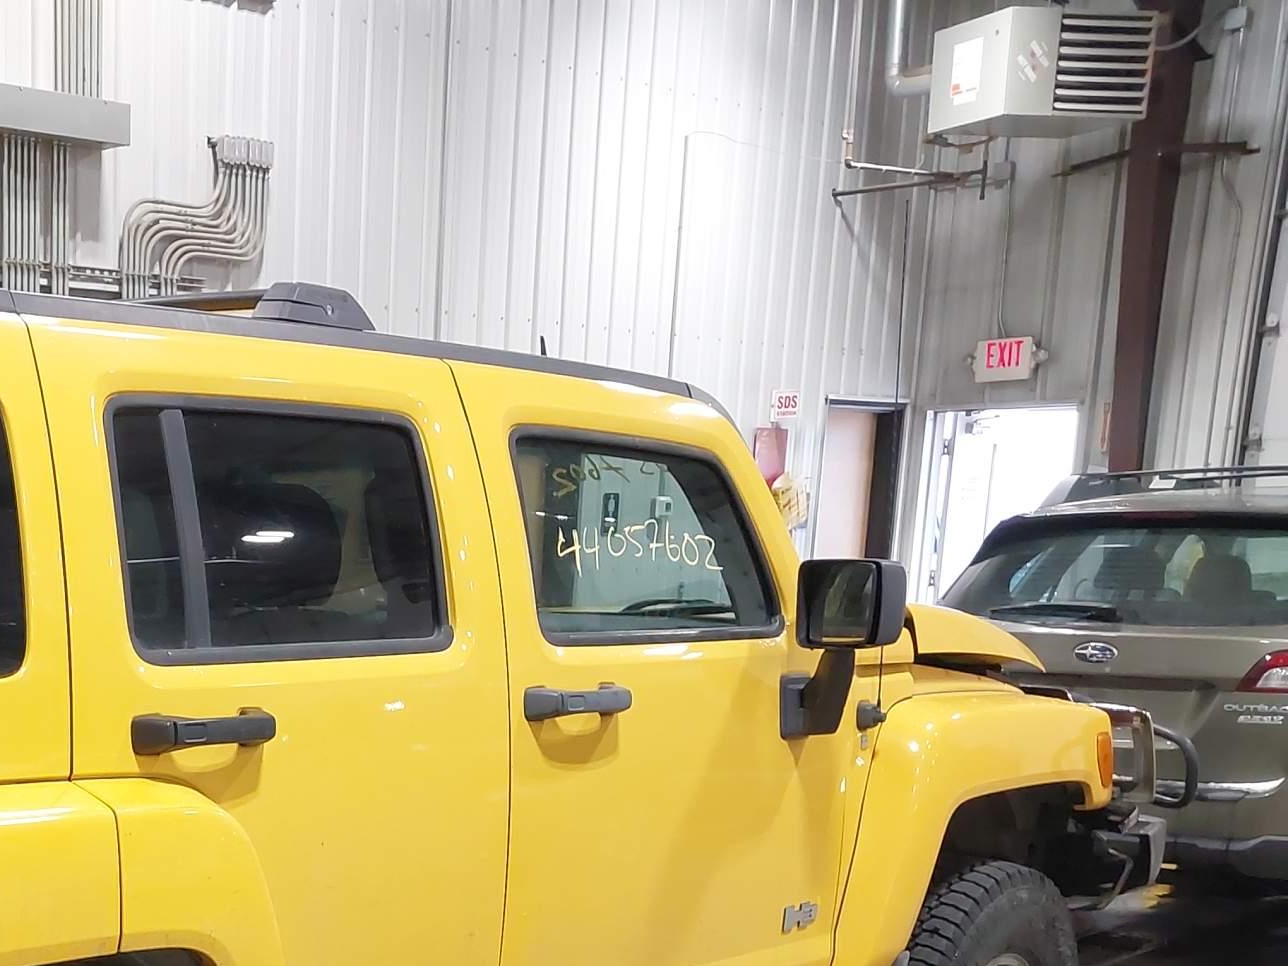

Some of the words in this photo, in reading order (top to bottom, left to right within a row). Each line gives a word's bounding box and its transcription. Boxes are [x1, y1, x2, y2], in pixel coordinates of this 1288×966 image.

[984, 339, 1025, 369] EXIT
[776, 394, 798, 410] SDS
[557, 517, 724, 578] 44057602
[782, 901, 818, 935] H3
